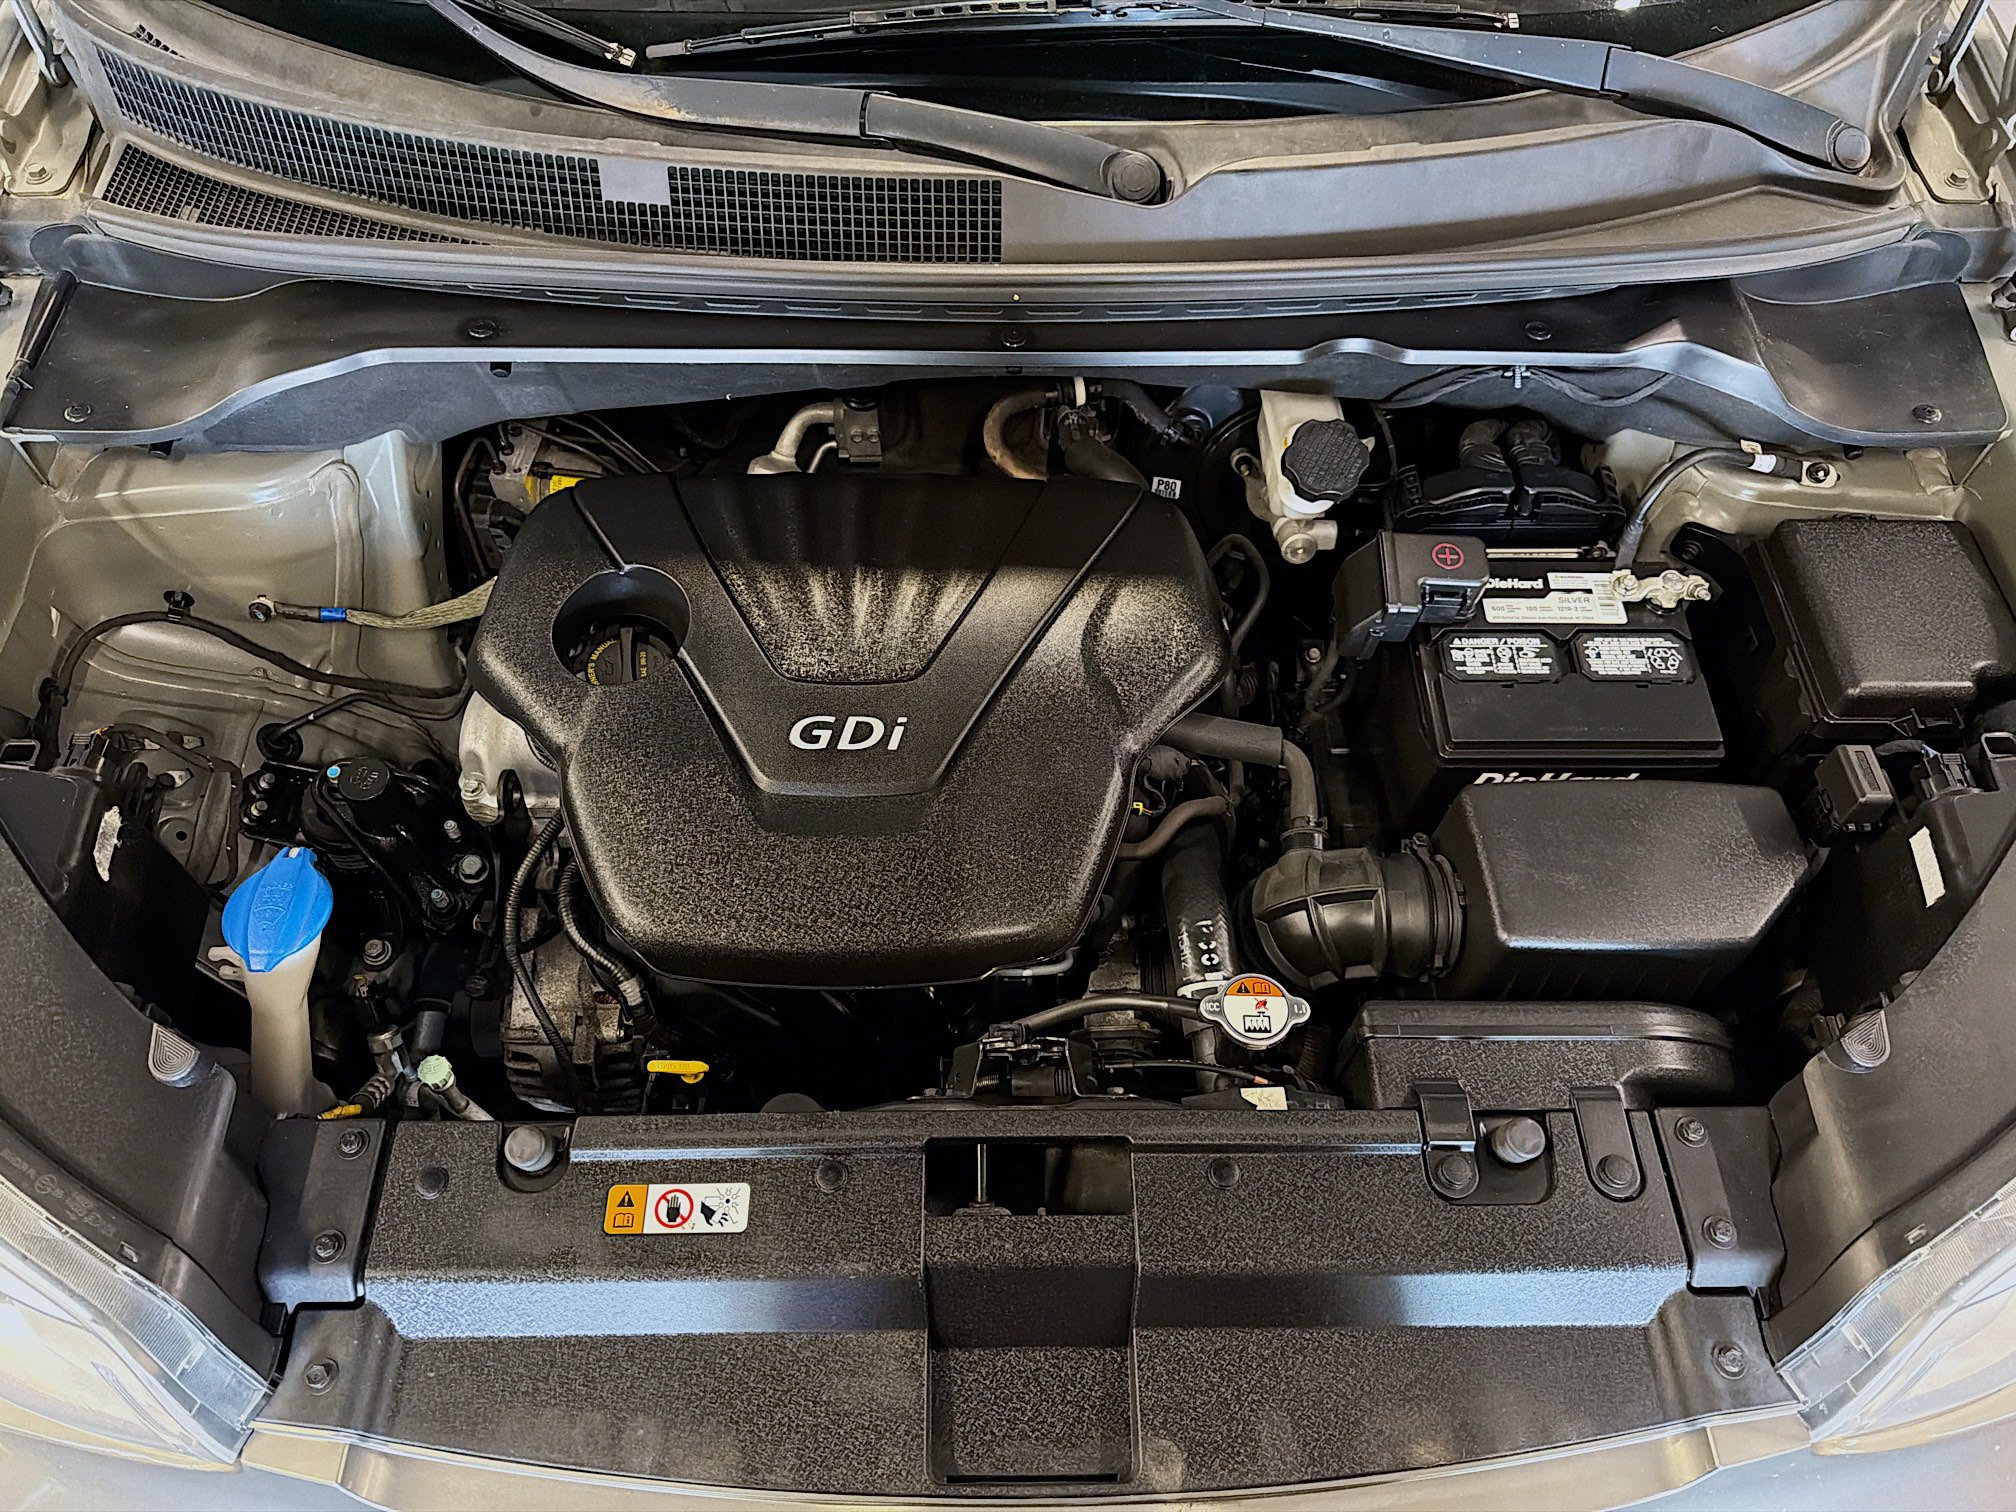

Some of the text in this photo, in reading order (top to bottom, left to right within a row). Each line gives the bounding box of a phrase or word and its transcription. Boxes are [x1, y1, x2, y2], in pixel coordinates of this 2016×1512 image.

[1156, 479, 1177, 492] P80
[1487, 578, 1544, 589] DieHard
[1558, 596, 1590, 604] SILVER
[789, 715, 908, 750] GDi
[1473, 772, 1640, 785] DiHd
